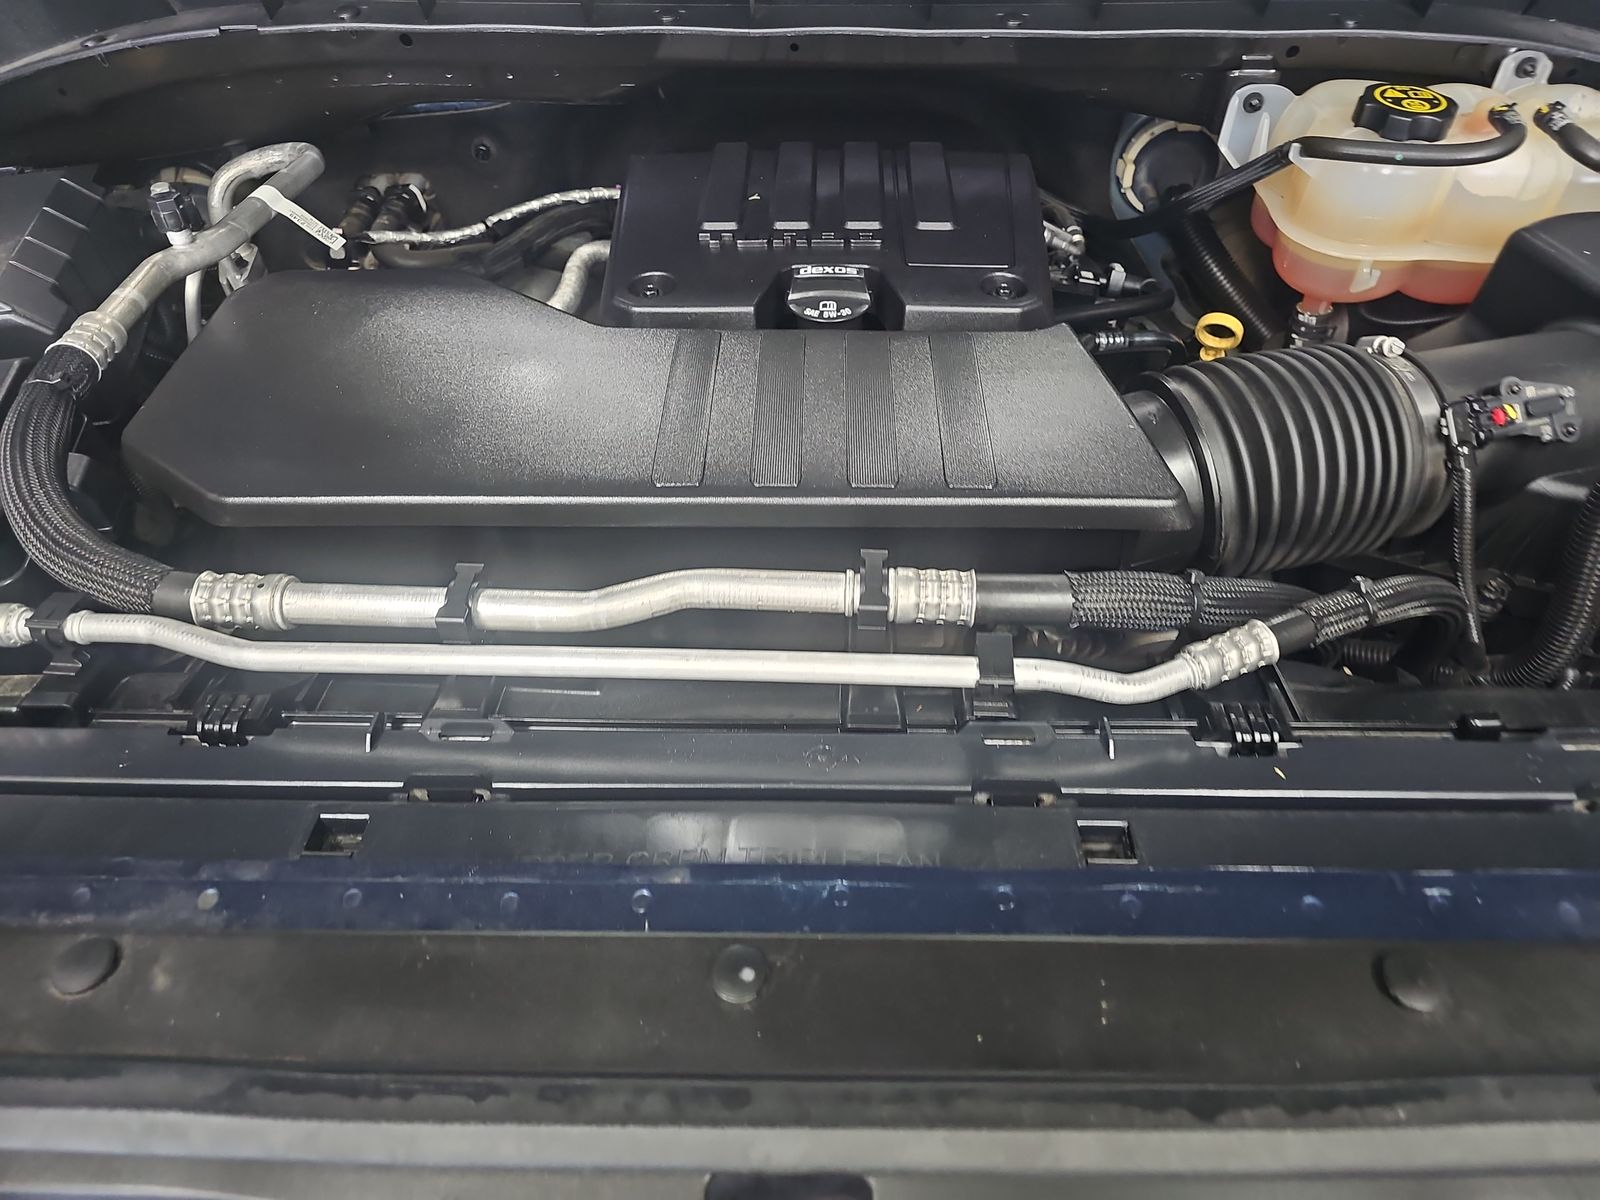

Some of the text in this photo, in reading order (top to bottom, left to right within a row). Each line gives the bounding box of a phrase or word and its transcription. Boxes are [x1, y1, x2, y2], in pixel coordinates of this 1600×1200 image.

[799, 264, 858, 275] dexos
[803, 307, 852, 318] SAE 5W-30
